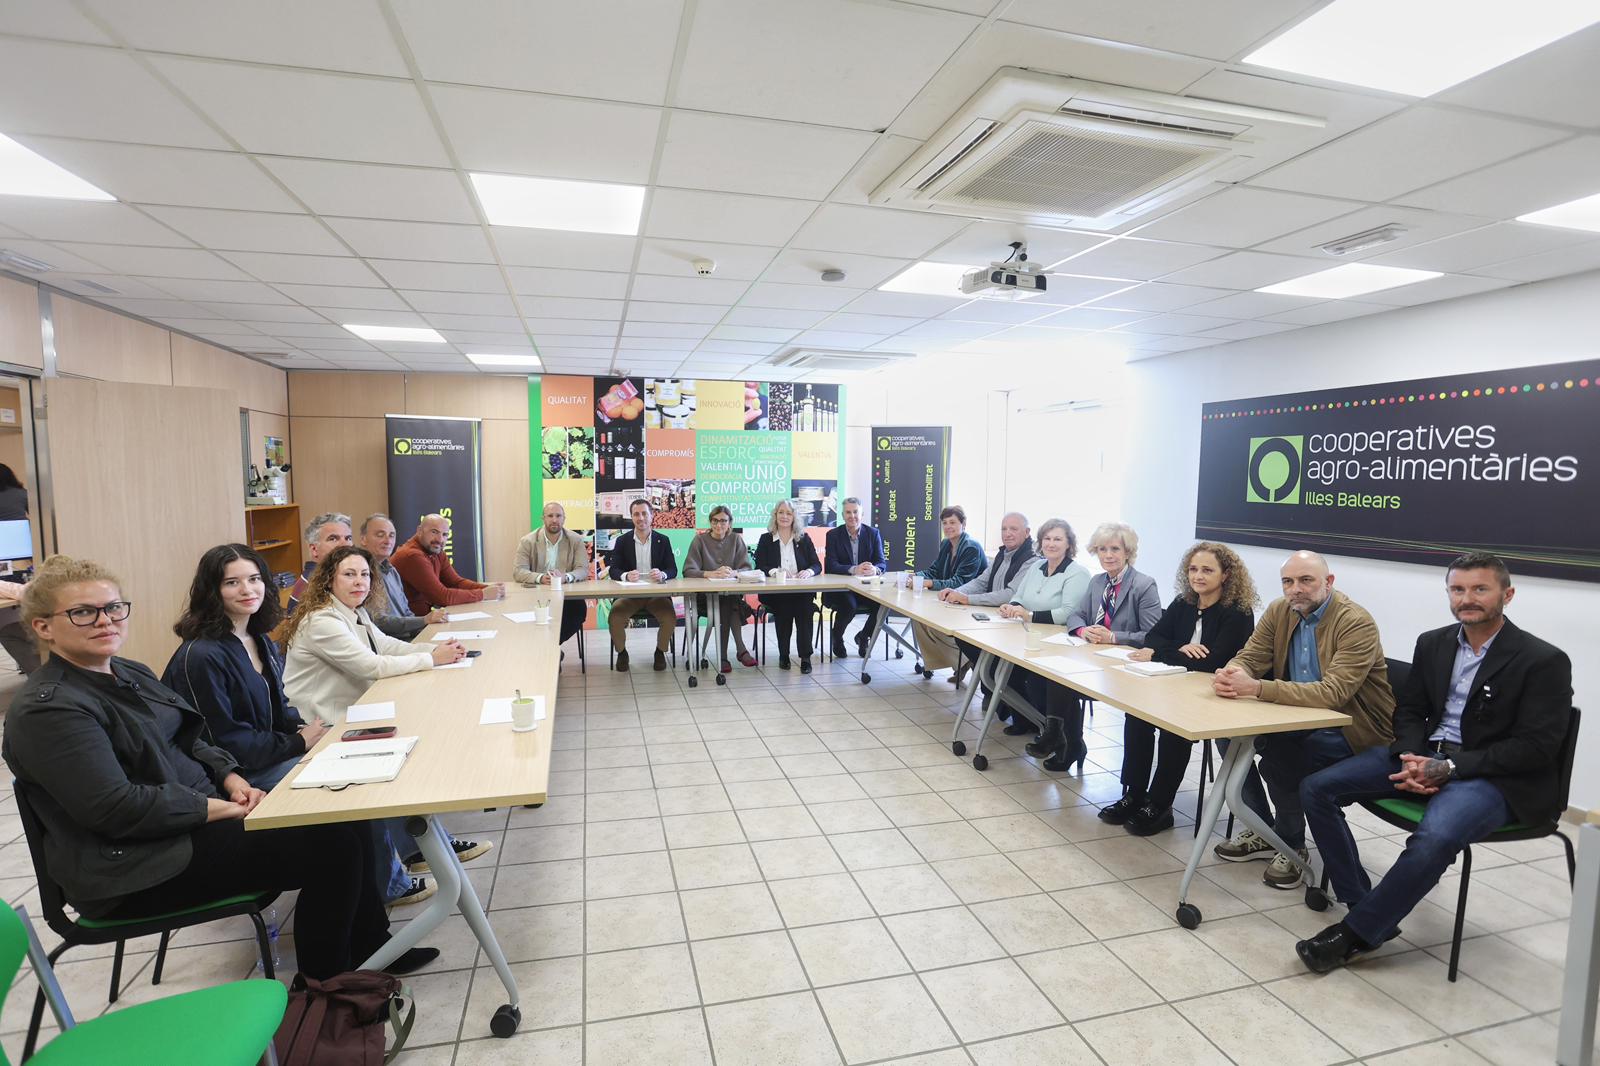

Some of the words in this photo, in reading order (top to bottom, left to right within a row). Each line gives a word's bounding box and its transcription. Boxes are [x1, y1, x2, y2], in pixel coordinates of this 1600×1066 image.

[547, 394, 587, 405] QUALITAT
[1308, 424, 1496, 455] cooperatives
[647, 447, 695, 457] COMPROMÍS
[700, 446, 756, 460] ESFORÇ
[701, 462, 742, 471] VALENTIA
[744, 460, 787, 480] UNIÓ
[1307, 452, 1579, 485] agro-alimentàries
[701, 479, 786, 494] COMPROMÍS
[1305, 491, 1334, 506] Illes
[1337, 492, 1401, 509] Balears
[904, 516, 916, 567] Ambient
